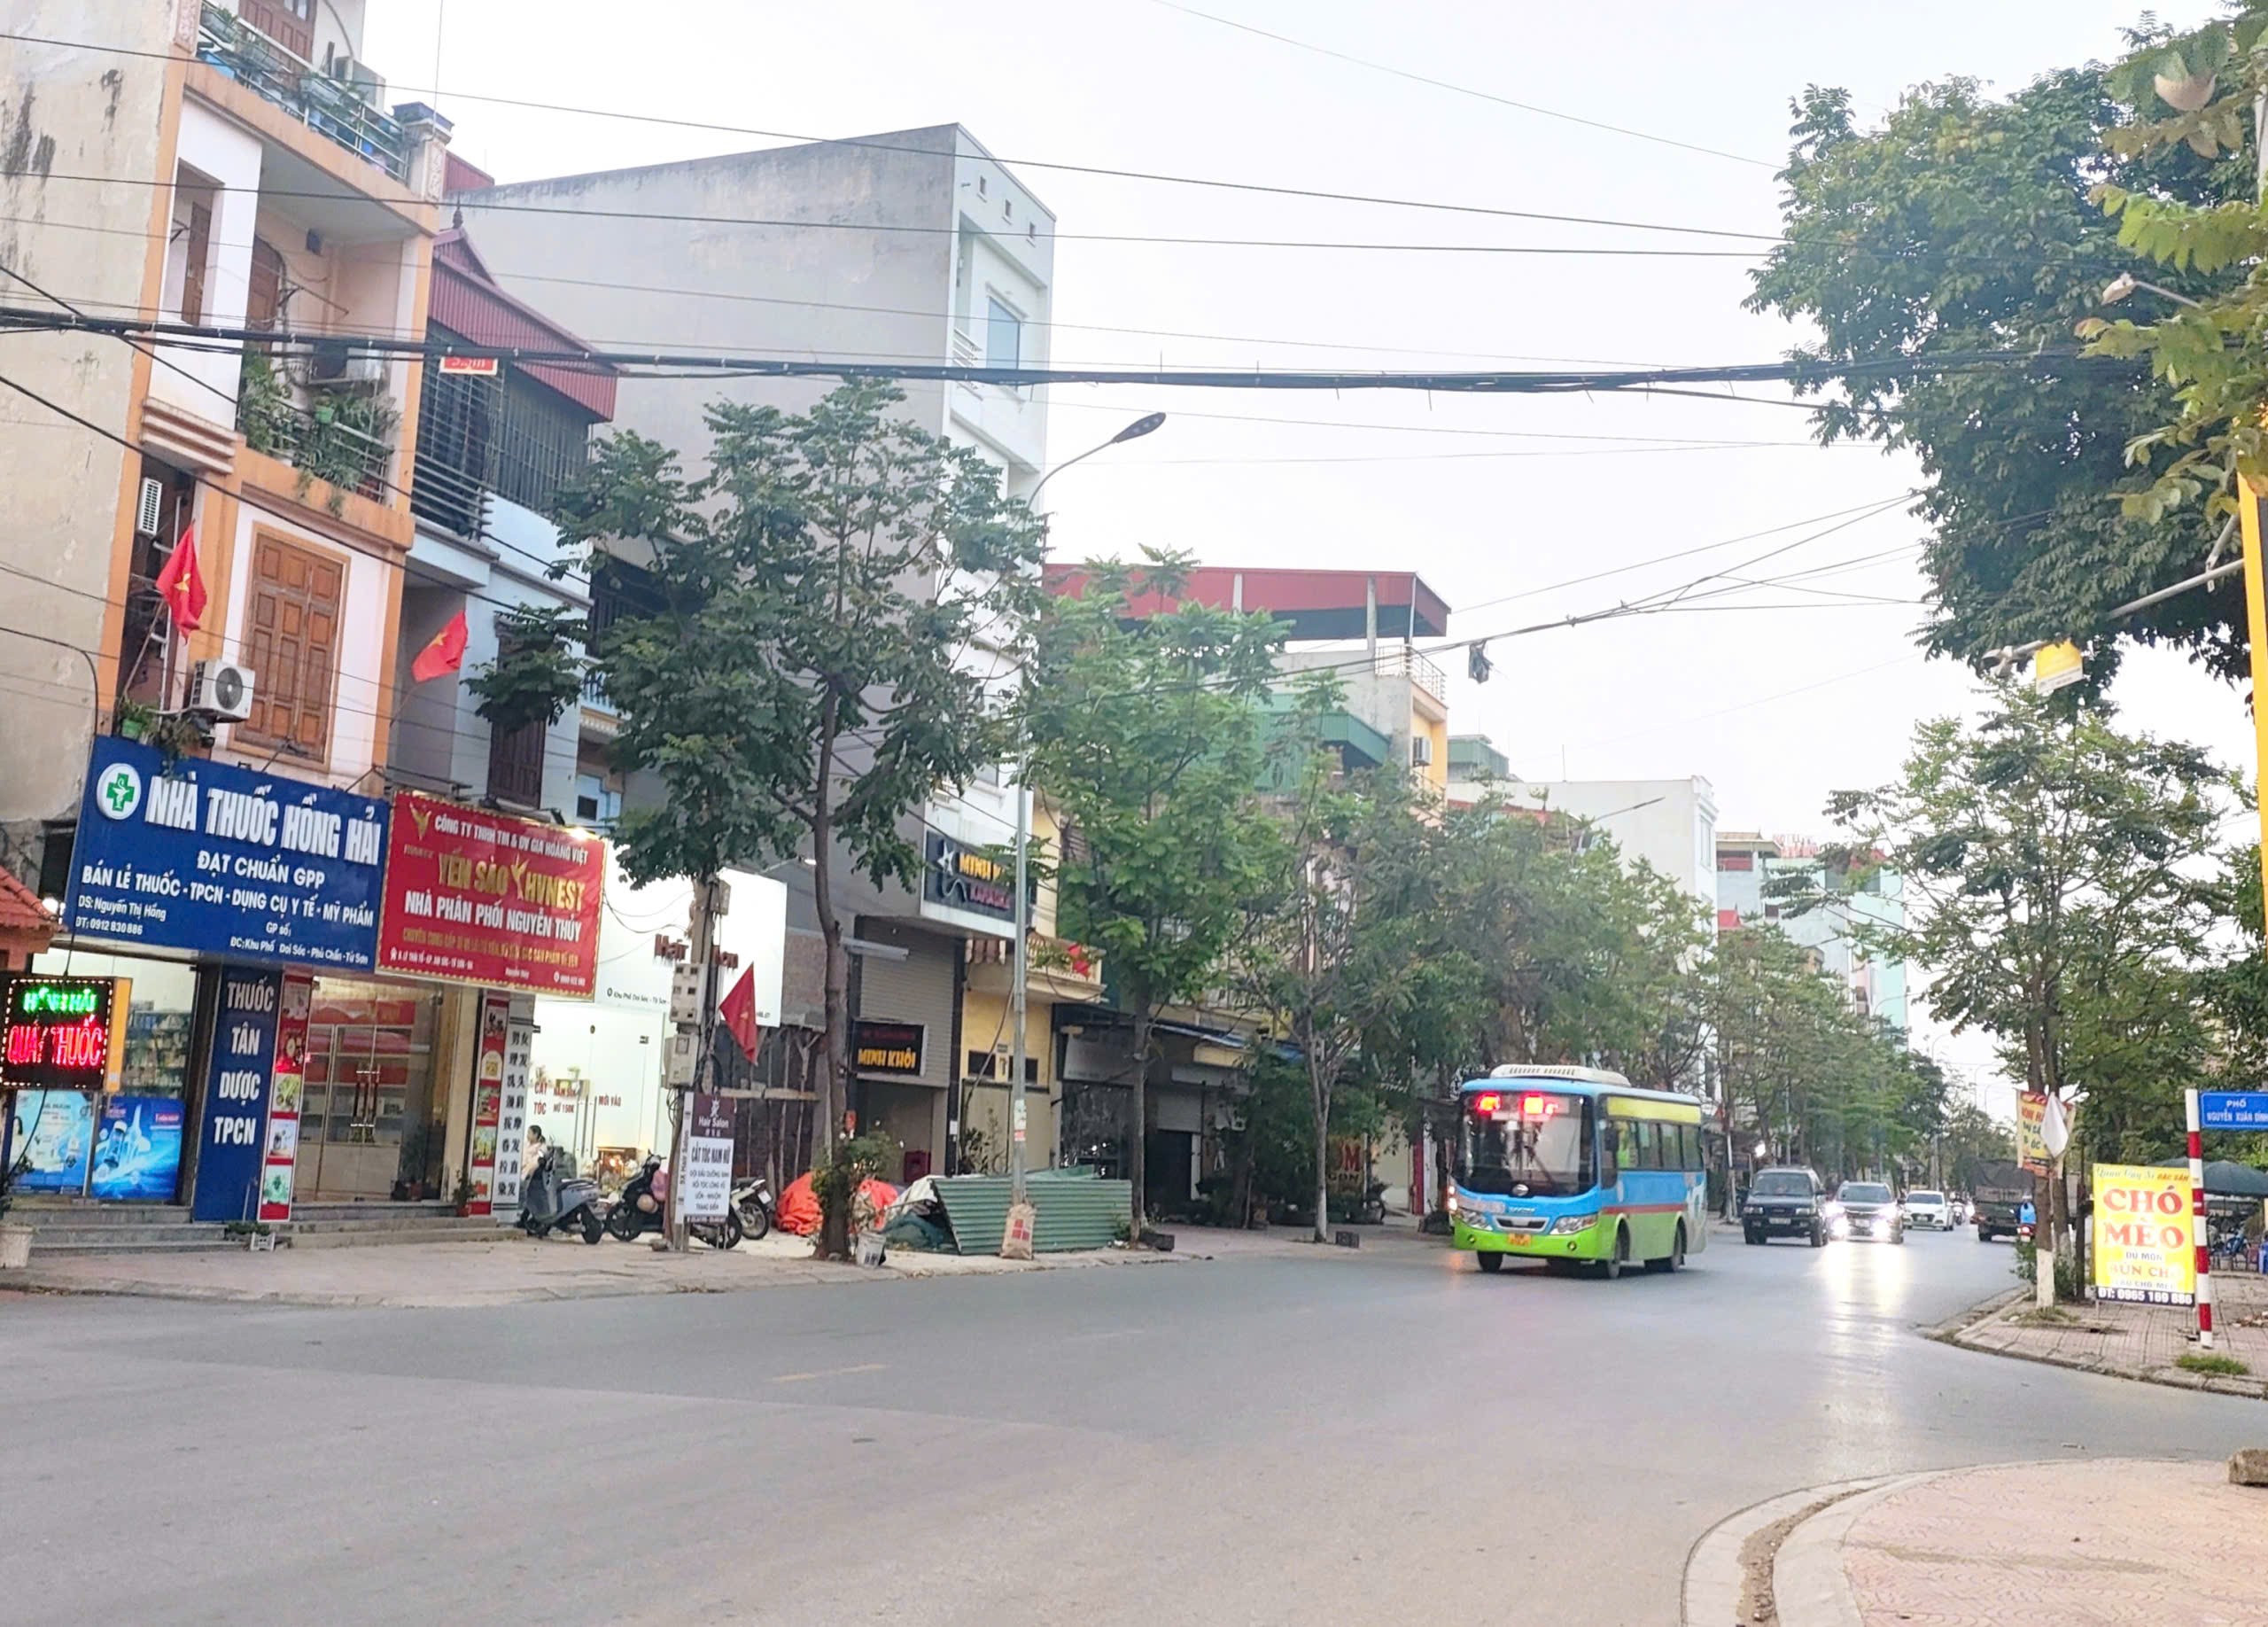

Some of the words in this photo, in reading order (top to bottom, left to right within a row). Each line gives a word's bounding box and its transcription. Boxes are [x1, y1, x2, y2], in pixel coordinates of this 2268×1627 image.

[144, 771, 198, 831] NHÀ
[205, 785, 279, 846] THUỐC
[344, 806, 382, 866] HẢI
[435, 814, 459, 834] CÔNG
[461, 819, 471, 837] TY
[474, 825, 496, 843] TNHH
[531, 840, 544, 853] GIA
[545, 841, 571, 861] HOÀNG
[572, 845, 589, 868] VIỆT
[197, 850, 231, 878] ĐẠT
[234, 853, 290, 884] CHUẨN
[293, 868, 325, 889] GPP
[439, 845, 472, 890] YẾN
[474, 855, 509, 895] SÀO
[78, 895, 93, 908] DS:
[94, 897, 127, 915] Nguyễn
[129, 902, 143, 920] Thị
[82, 860, 113, 887] BÁN
[115, 863, 132, 890] LẺ
[135, 868, 182, 897] THUỐC
[190, 882, 224, 905] TPCN
[231, 889, 267, 914] DỤNG
[269, 894, 288, 919] CỤ
[291, 899, 300, 916] Y
[302, 893, 319, 918] TẾ
[322, 900, 341, 922] MỸ
[342, 901, 374, 928] PHẨM
[90, 918, 109, 931] 0912
[110, 922, 127, 934] 830
[266, 922, 278, 934] GP
[405, 890, 432, 916] NHÀ
[436, 895, 472, 923] PHÂN
[475, 899, 504, 930] PHỐI
[506, 907, 552, 938] NGUYỄN
[227, 975, 275, 1012] THUỐC
[50, 1014, 103, 1066] THUỐC
[231, 1023, 260, 1055] TÂN
[219, 1070, 260, 1106] DƯỢC
[2225, 1097, 2247, 1108] PHỐ
[214, 1117, 256, 1145] TPCN
[712, 1117, 729, 1129] Salon
[2206, 1108, 2233, 1122] NGUYỄN
[2103, 1185, 2183, 1215] CHÓ
[2103, 1217, 2185, 1249] MÈO
